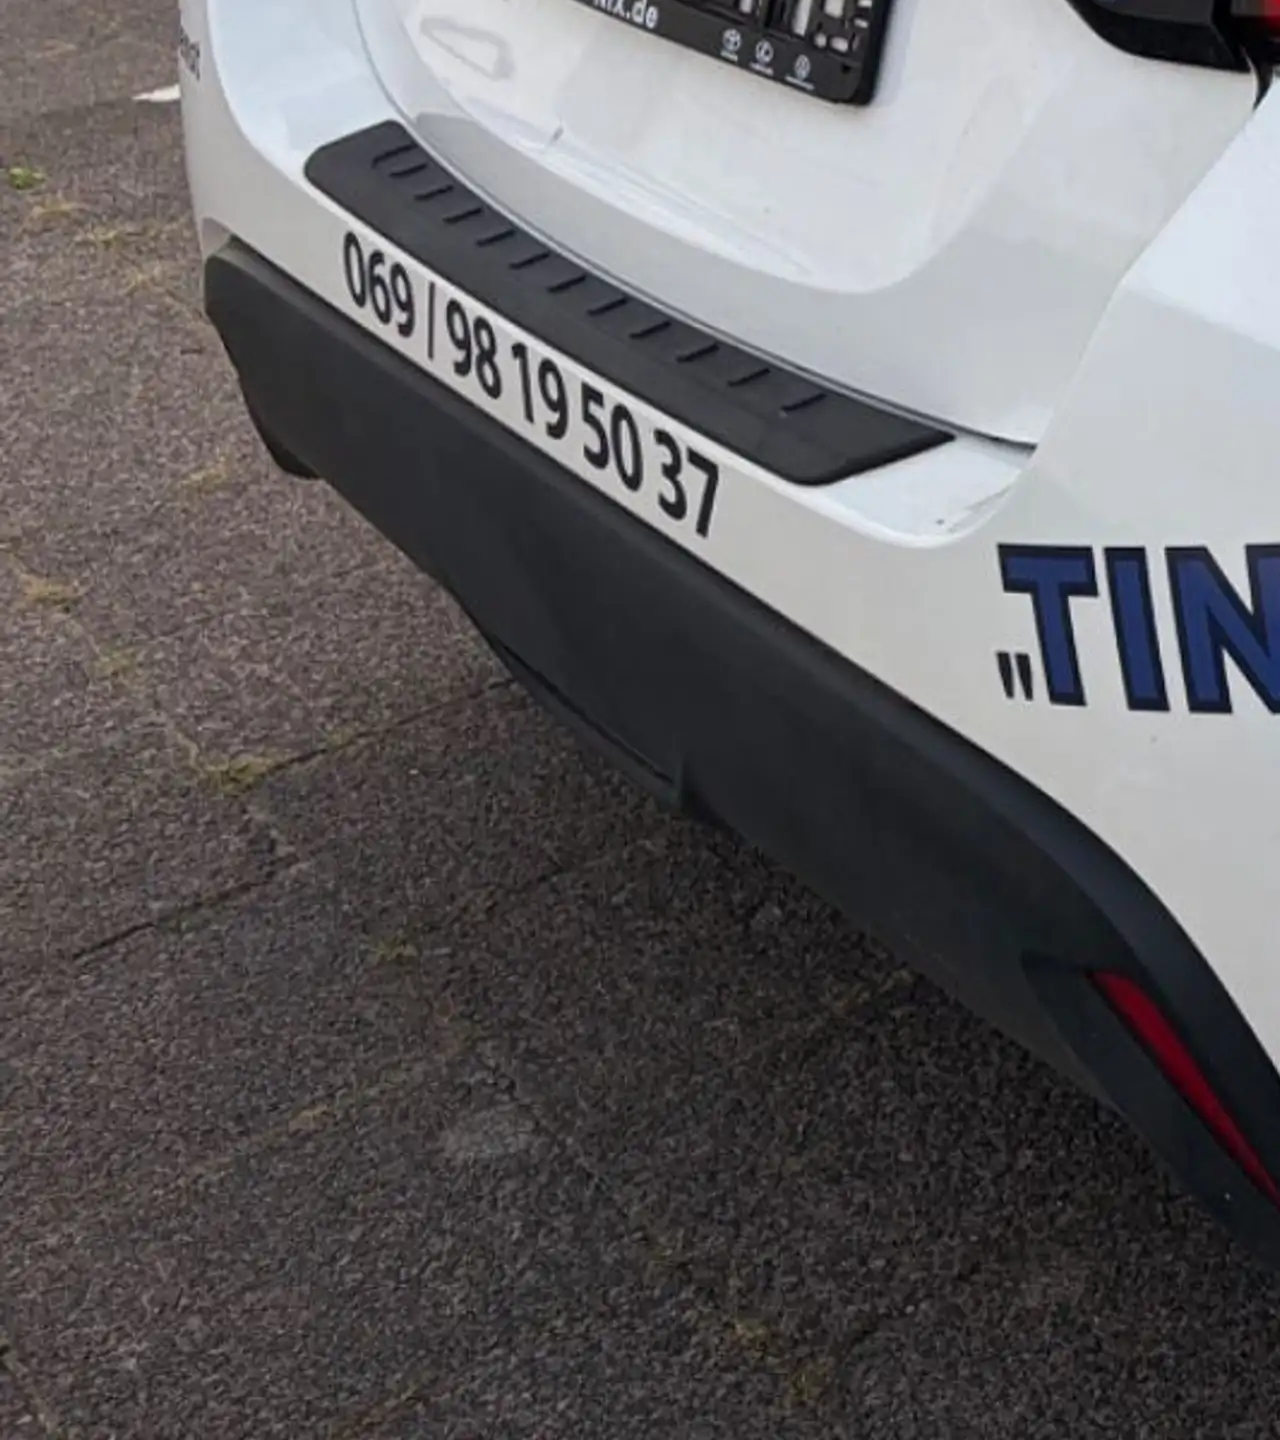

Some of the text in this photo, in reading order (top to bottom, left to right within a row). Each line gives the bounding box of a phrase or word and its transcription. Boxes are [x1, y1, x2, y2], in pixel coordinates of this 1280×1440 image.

[342, 230, 416, 339] 069
[446, 298, 502, 400] 98
[511, 341, 569, 441] 19
[581, 380, 645, 493] 50
[653, 427, 720, 538] 37
